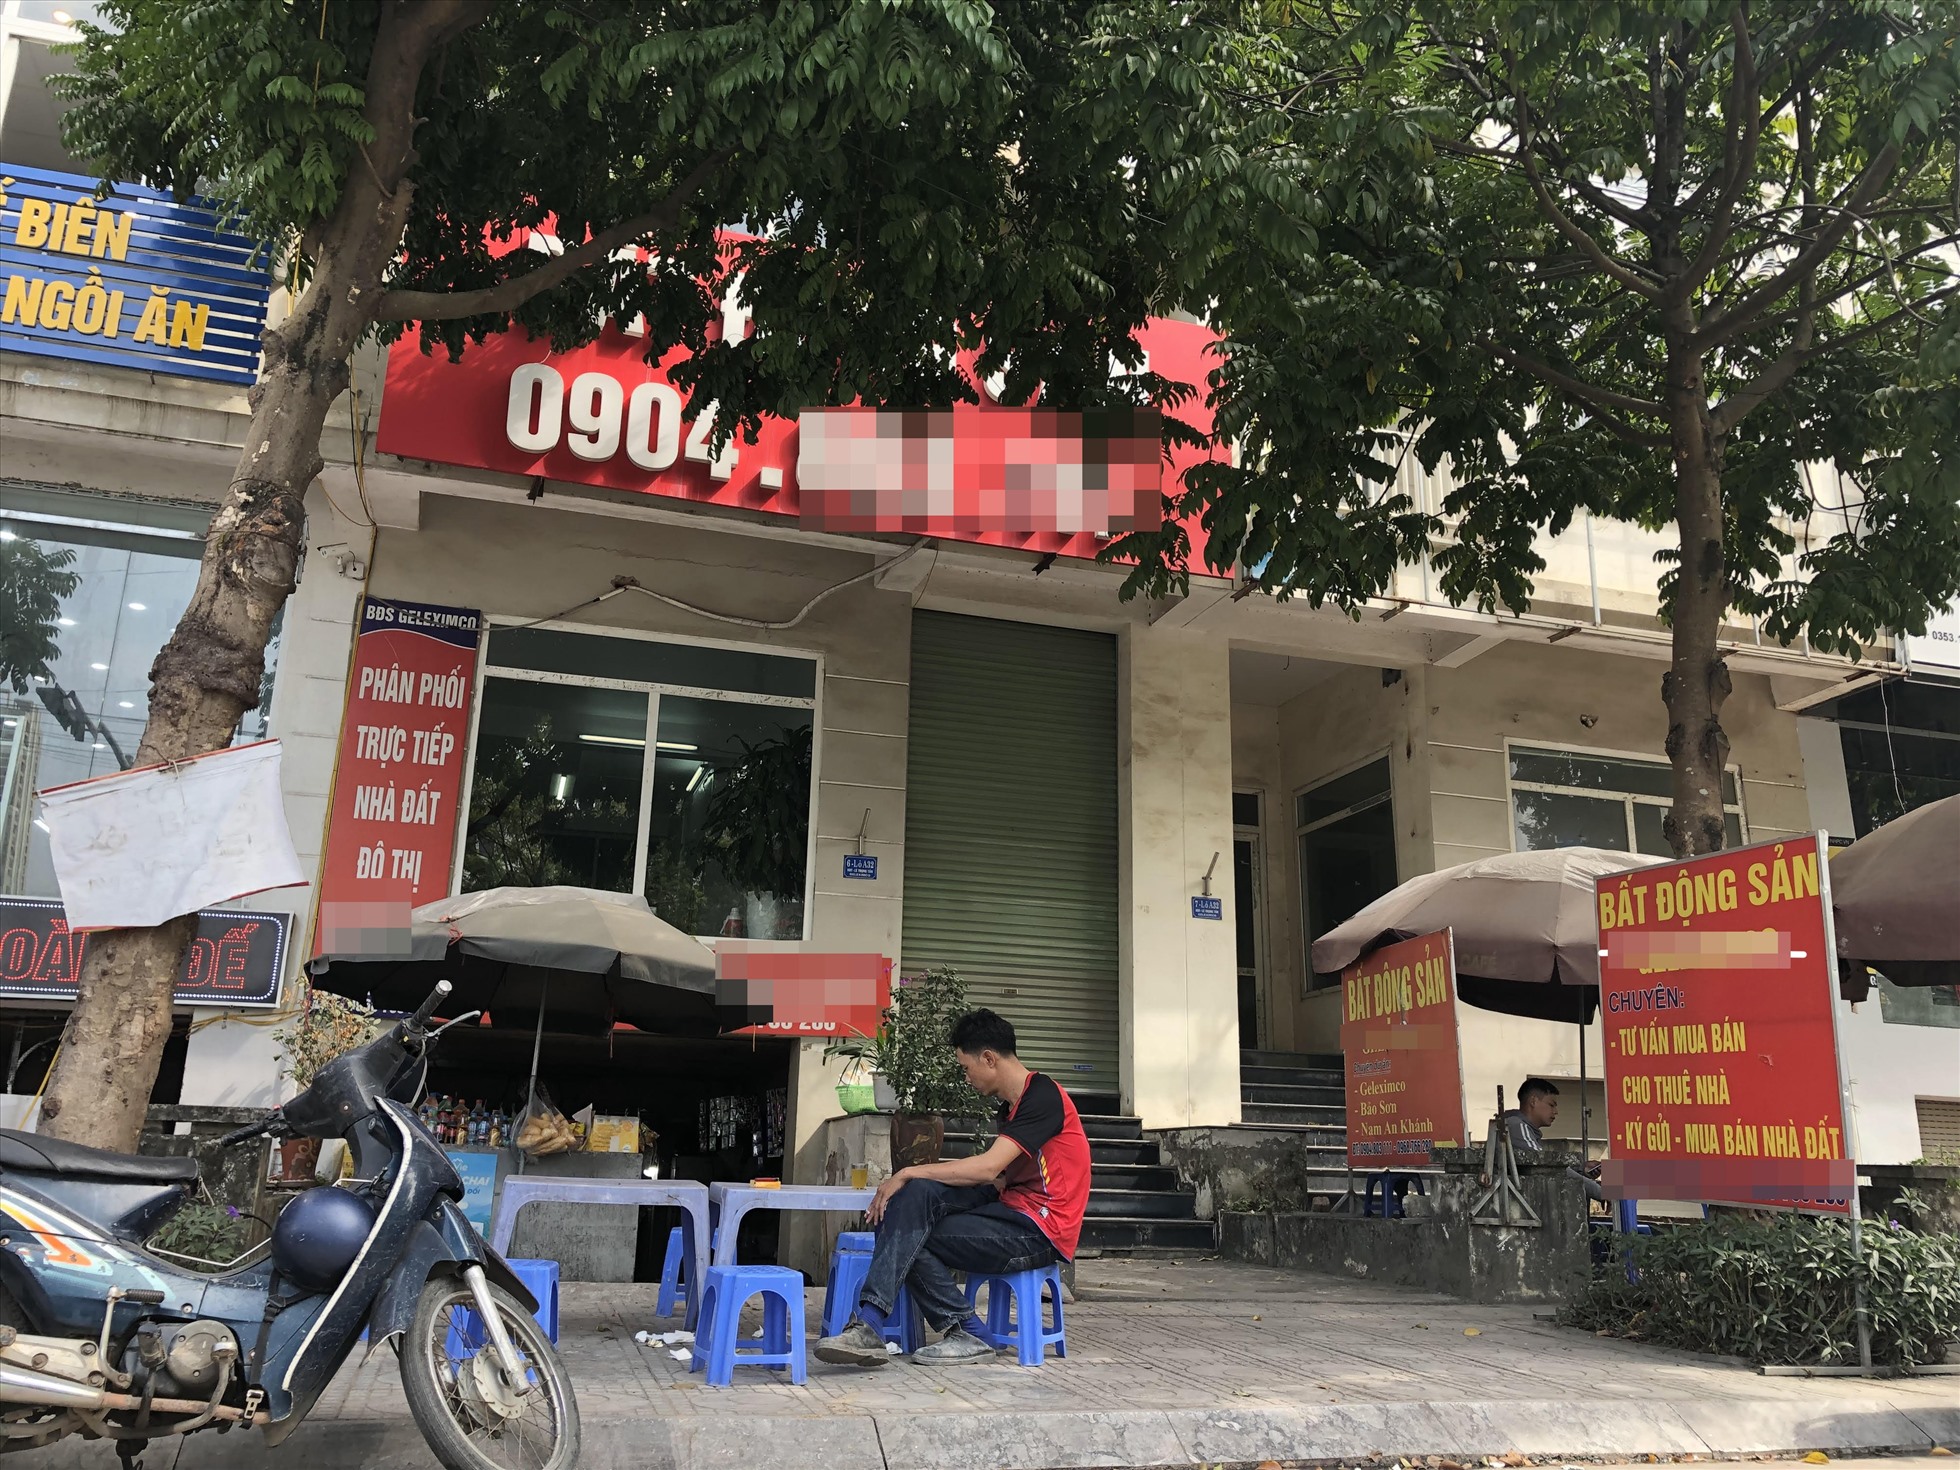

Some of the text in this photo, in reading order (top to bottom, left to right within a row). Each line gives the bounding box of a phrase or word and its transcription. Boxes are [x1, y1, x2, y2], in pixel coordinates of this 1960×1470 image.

[1, 265, 210, 351] NGỒI ĂN
[506, 362, 800, 490] 0904.
[366, 605, 477, 629] BĐS GELEXIMCO
[359, 663, 466, 709] PHÂN PHỐI
[356, 722, 455, 768] TRỰC TIẾP
[353, 779, 441, 825] NHÀ ĐẤT
[356, 840, 423, 893] ĐÔ THỊ
[1600, 844, 1820, 930] BẤT ĐỘNG SẢN
[0, 918, 89, 983] OÀ
[1347, 944, 1447, 1025] BẤT ĐỘNG SẢN
[1608, 982, 1685, 1013] CHUYÊN:
[1618, 1016, 1747, 1056] TƯ VẤN MUA BÁN
[1359, 1080, 1406, 1096] Geleximco
[1360, 1100, 1397, 1116] Bảo Sơn
[1622, 1068, 1731, 1105] CHO THUÊ NHÀ
[1361, 1118, 1433, 1136] Nam An Khánh
[1625, 1112, 1840, 1160] KÝ GỬI MUA BÁN NHÀ ĐẤT
[462, 1176, 490, 1186] CHAI
